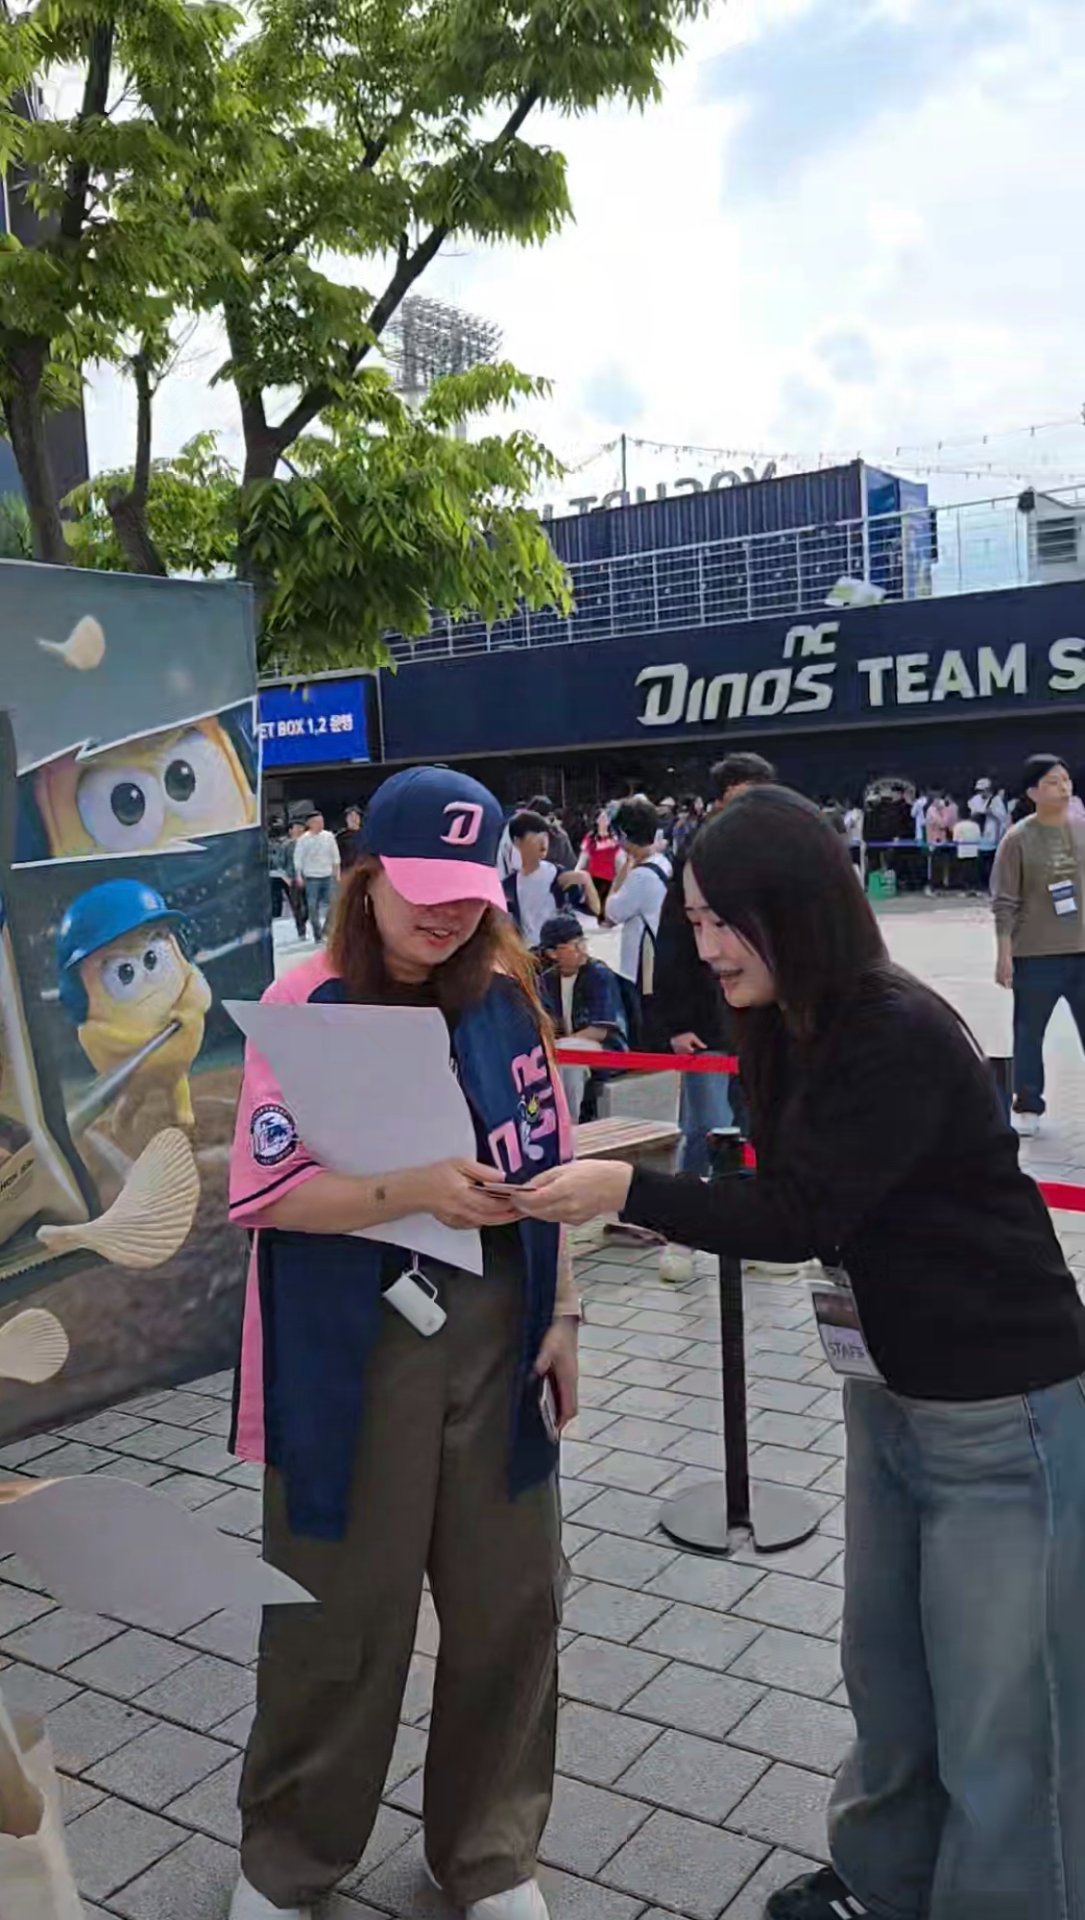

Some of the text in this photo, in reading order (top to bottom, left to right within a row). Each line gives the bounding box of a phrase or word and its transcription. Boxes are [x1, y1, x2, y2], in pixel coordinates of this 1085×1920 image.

[857, 642, 1027, 706] TEAM
[277, 719, 305, 737] BOX
[440, 801, 483, 845] D
